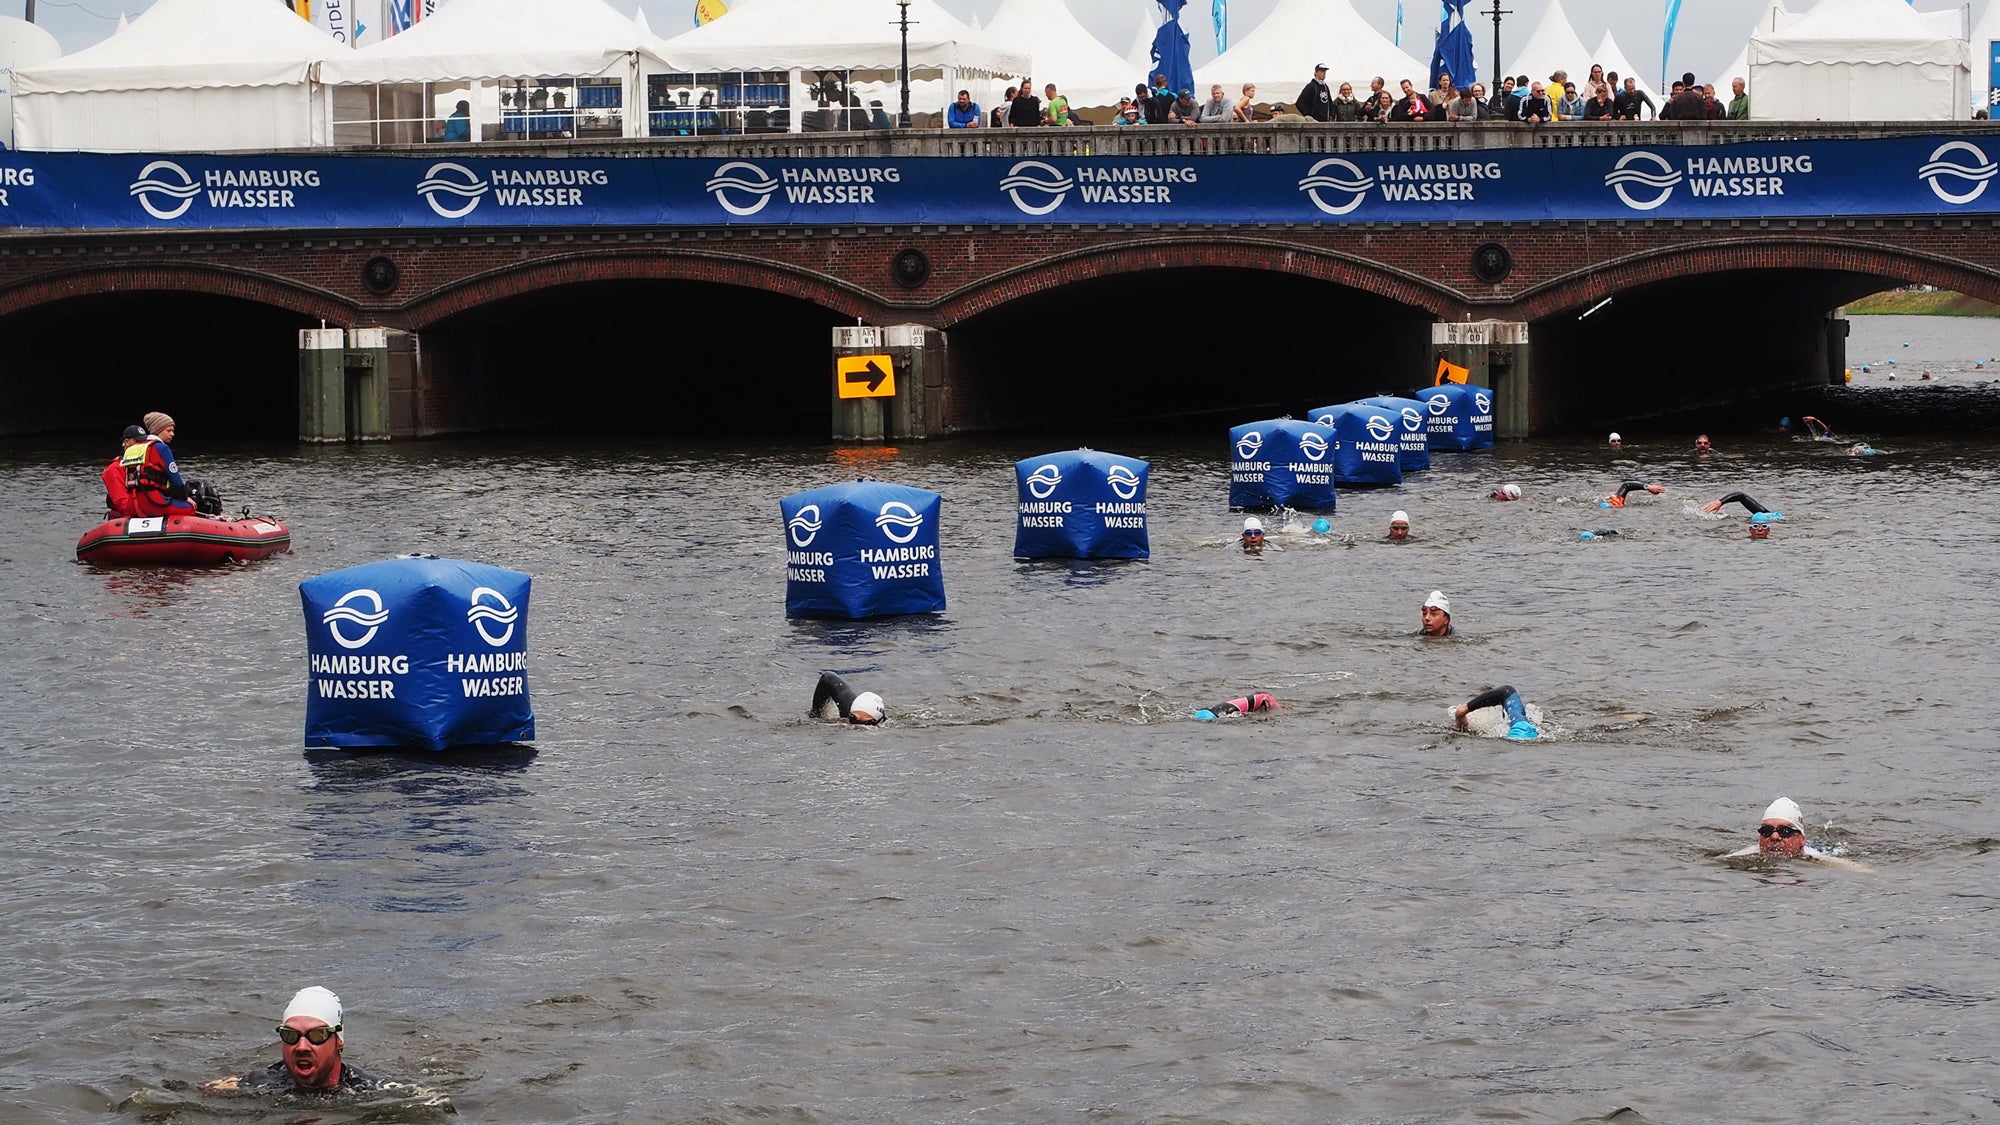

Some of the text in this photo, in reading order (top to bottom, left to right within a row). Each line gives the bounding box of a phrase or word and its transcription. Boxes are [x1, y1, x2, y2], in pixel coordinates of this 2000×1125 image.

[1379, 163, 1501, 181] HAMBURG
[1688, 156, 1812, 175] HAMBURG
[205, 169, 320, 187] HAMBURG
[492, 169, 607, 186] HAMBURG
[782, 167, 900, 183] HAMBURG
[1077, 167, 1196, 183] HAMBURG
[786, 186, 875, 203] WASSER
[1081, 186, 1172, 202] WASSER
[1381, 183, 1474, 201] WASSER
[1690, 177, 1784, 196] WASSER
[208, 190, 295, 207] WASSER
[495, 189, 583, 205] WASSER
[1355, 441, 1398, 454] HAMBURG
[1362, 453, 1395, 464] WASSER
[1289, 462, 1333, 473] HAMBURG
[1233, 473, 1264, 482] WASSER
[1296, 474, 1330, 484] WASSER
[1020, 501, 1072, 514] HAMBURG
[141, 520, 150, 528] 5
[1023, 517, 1064, 528] WASSER
[1105, 517, 1143, 529] WASSER
[860, 545, 934, 563] HAMBURG
[872, 564, 929, 580] WASSER
[311, 654, 408, 675] HAMBURG
[447, 651, 528, 674] HAMBURG
[319, 679, 395, 698] WASSER
[462, 676, 523, 698] WASSER
